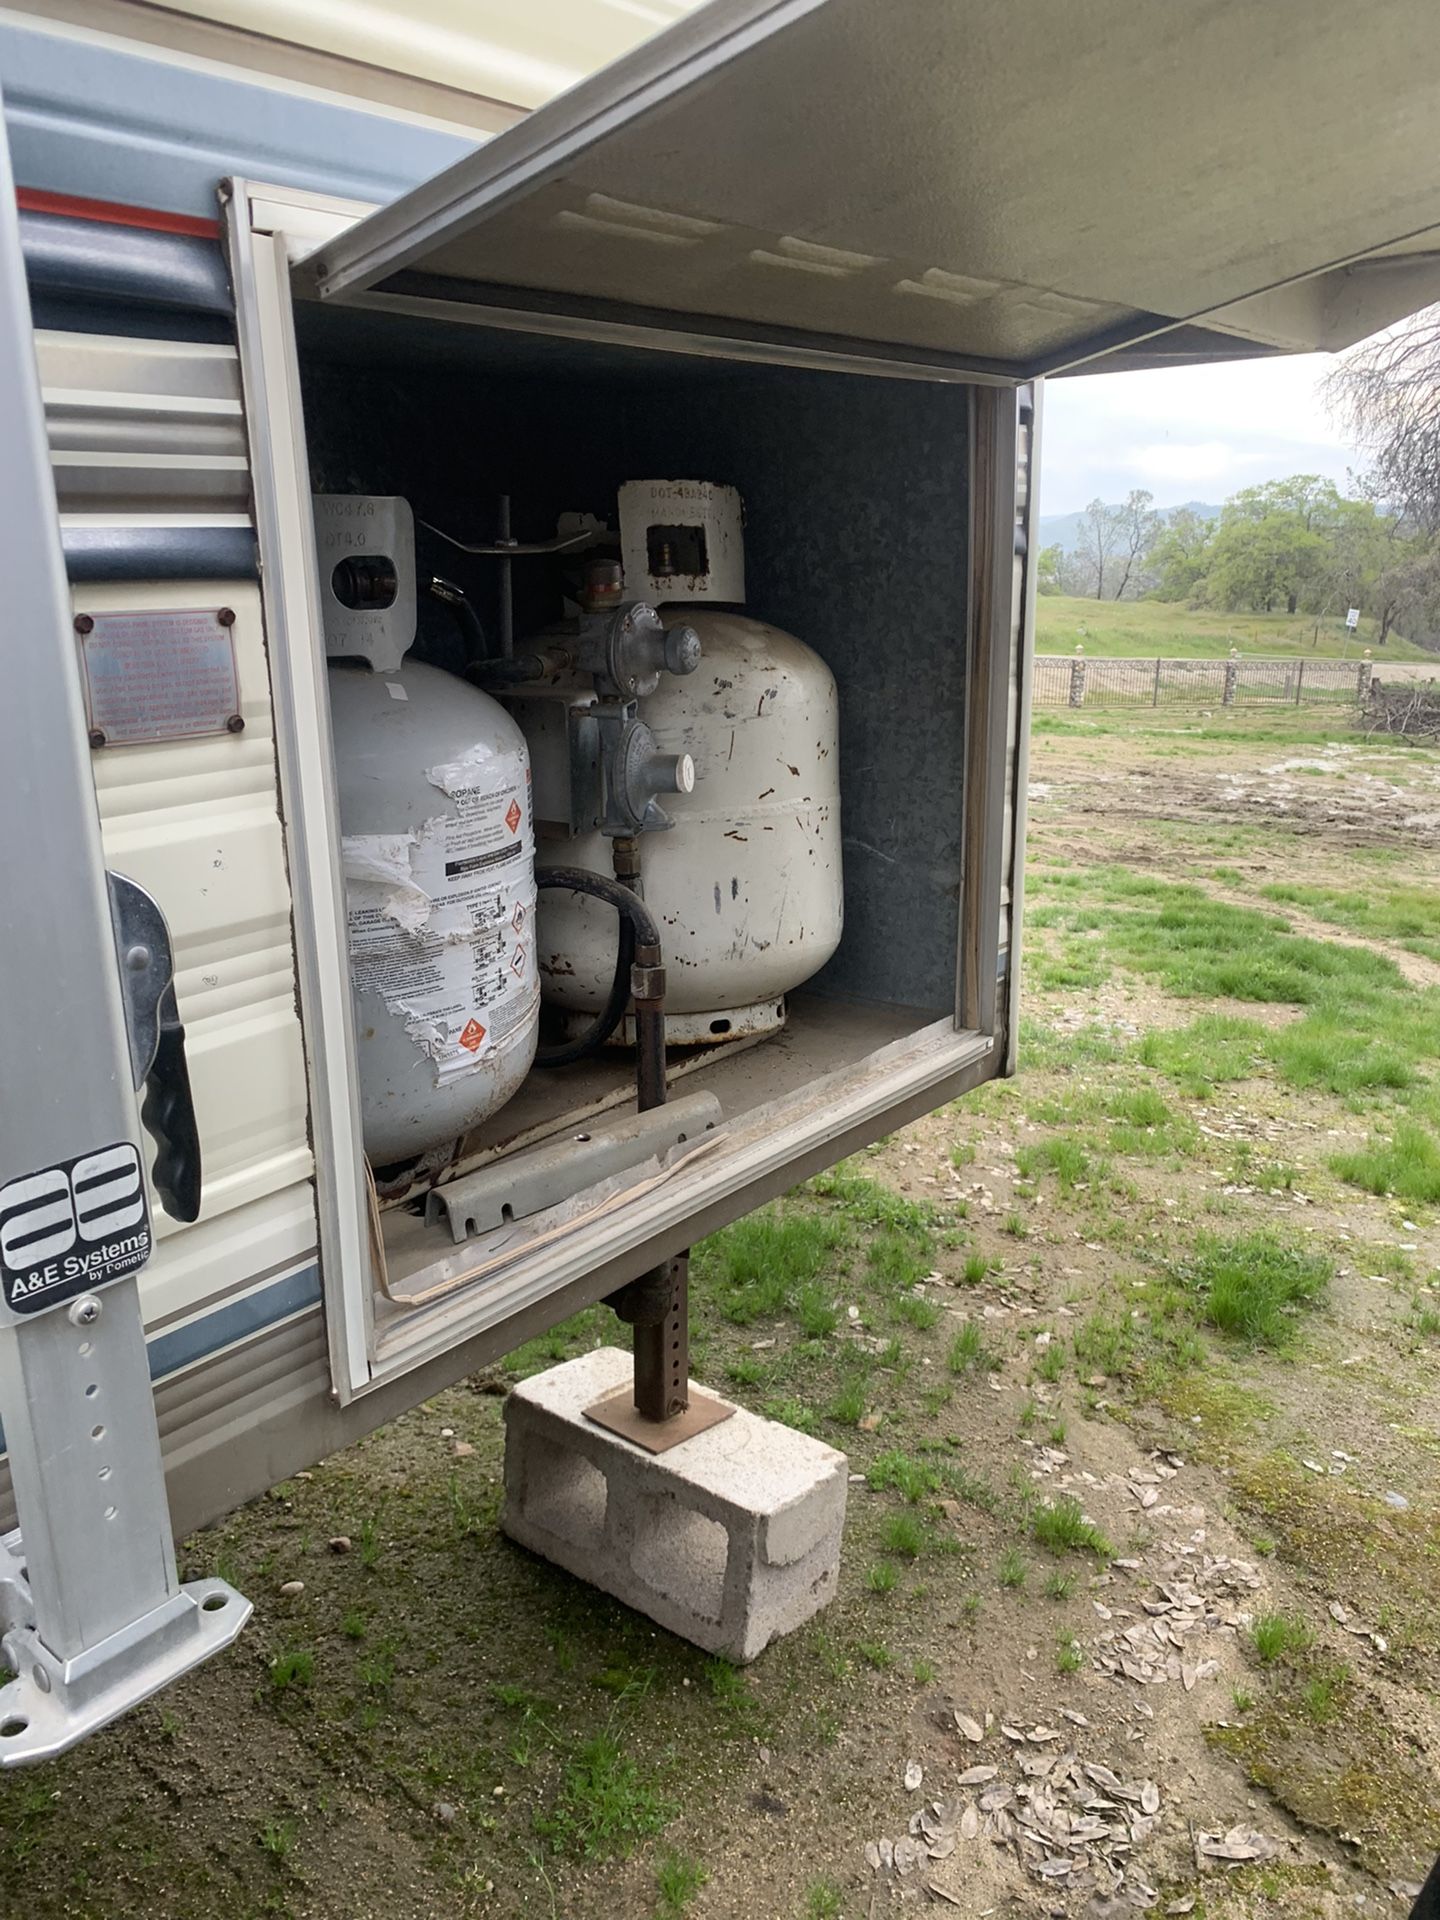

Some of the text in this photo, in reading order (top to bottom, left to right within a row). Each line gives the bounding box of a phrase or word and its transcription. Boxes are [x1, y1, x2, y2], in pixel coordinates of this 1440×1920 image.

[11, 1231, 149, 1299] A&E Systems
[89, 1250, 149, 1281] by Dometic
